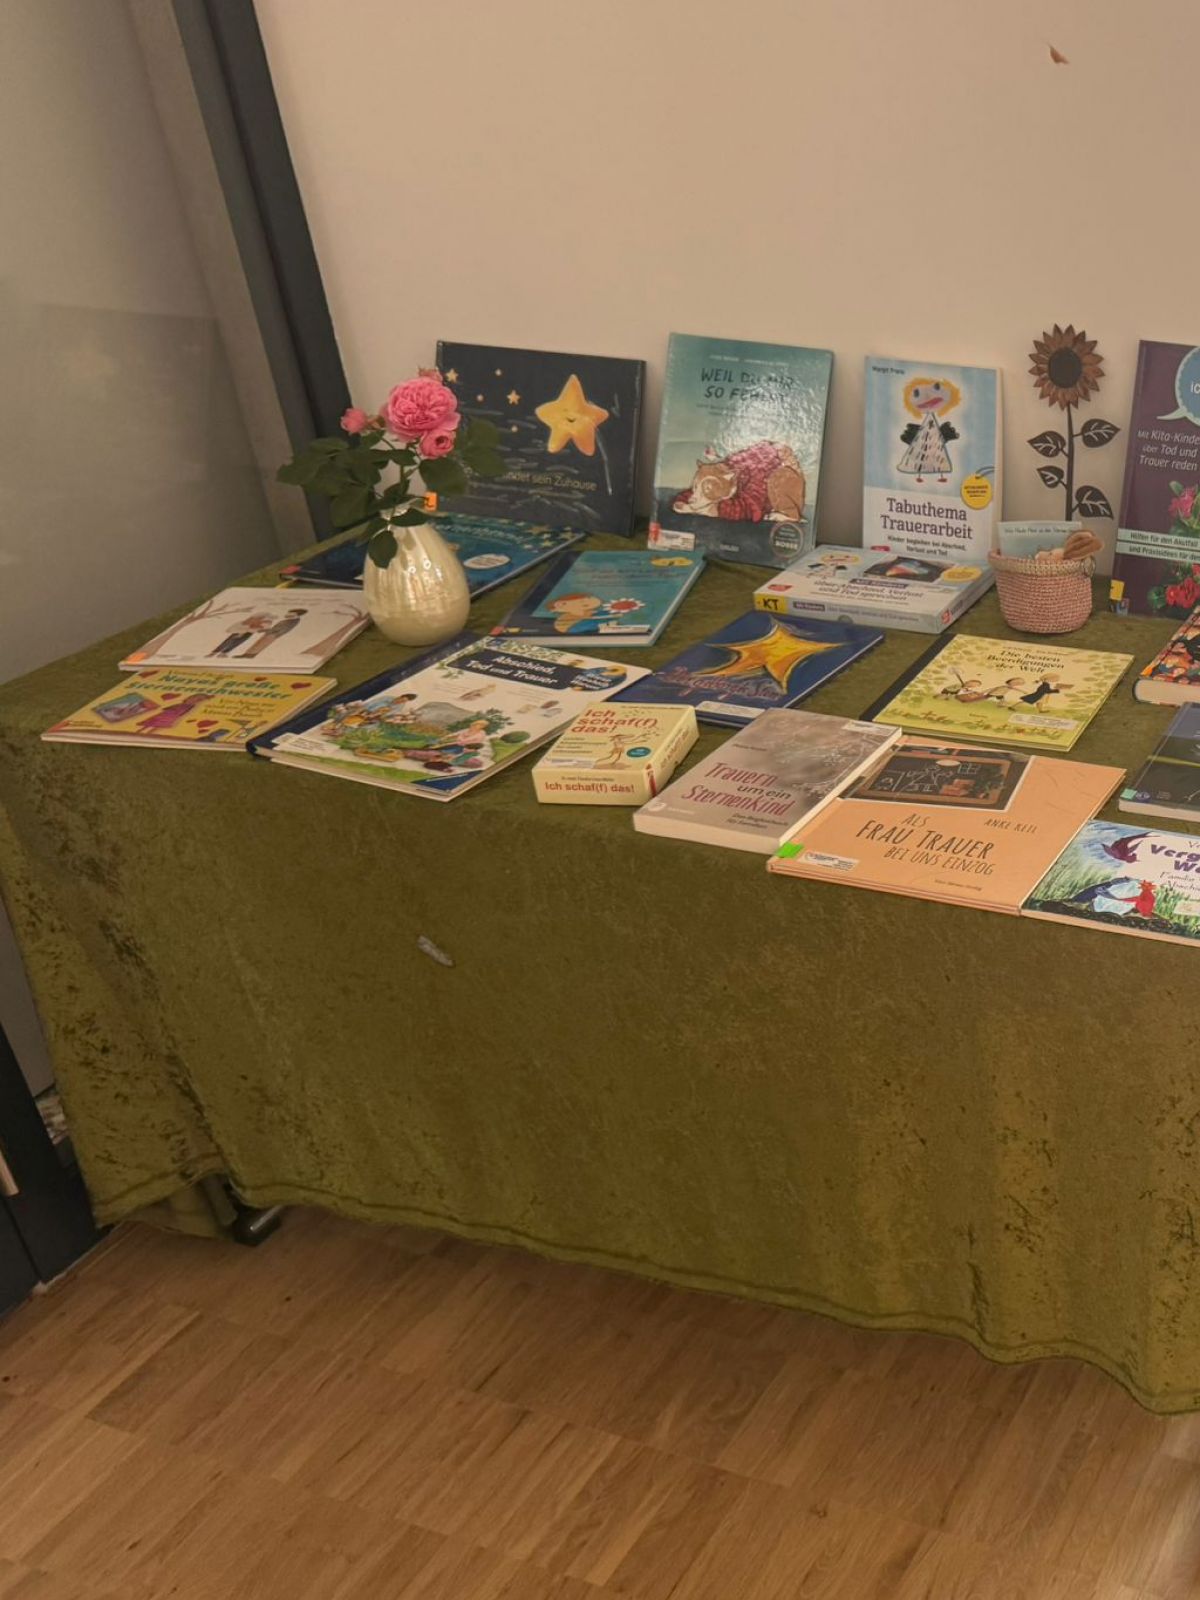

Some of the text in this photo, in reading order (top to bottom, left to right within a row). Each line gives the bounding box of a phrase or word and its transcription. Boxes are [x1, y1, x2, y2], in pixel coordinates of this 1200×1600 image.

[700, 367, 735, 383] WEIL
[704, 385, 725, 399] SO
[1160, 443, 1178, 457] Tod
[1179, 447, 1199, 459] und
[1138, 454, 1199, 472] Trauer reden
[554, 475, 598, 492] Zuhause
[886, 497, 968, 522] Tabuthema
[880, 514, 973, 540] Trauerarbeit
[761, 598, 779, 612] KT
[465, 659, 491, 672] Tod
[584, 708, 616, 718] Ich
[570, 724, 618, 735] das!
[704, 761, 779, 789] Trauern
[544, 780, 636, 794] Ich schaf(f) das!
[680, 784, 796, 817] Sternenkind
[901, 813, 929, 828] ALS
[856, 819, 995, 861] FRAU TRAUER
[883, 845, 998, 877] BEI UNS EINZOG
